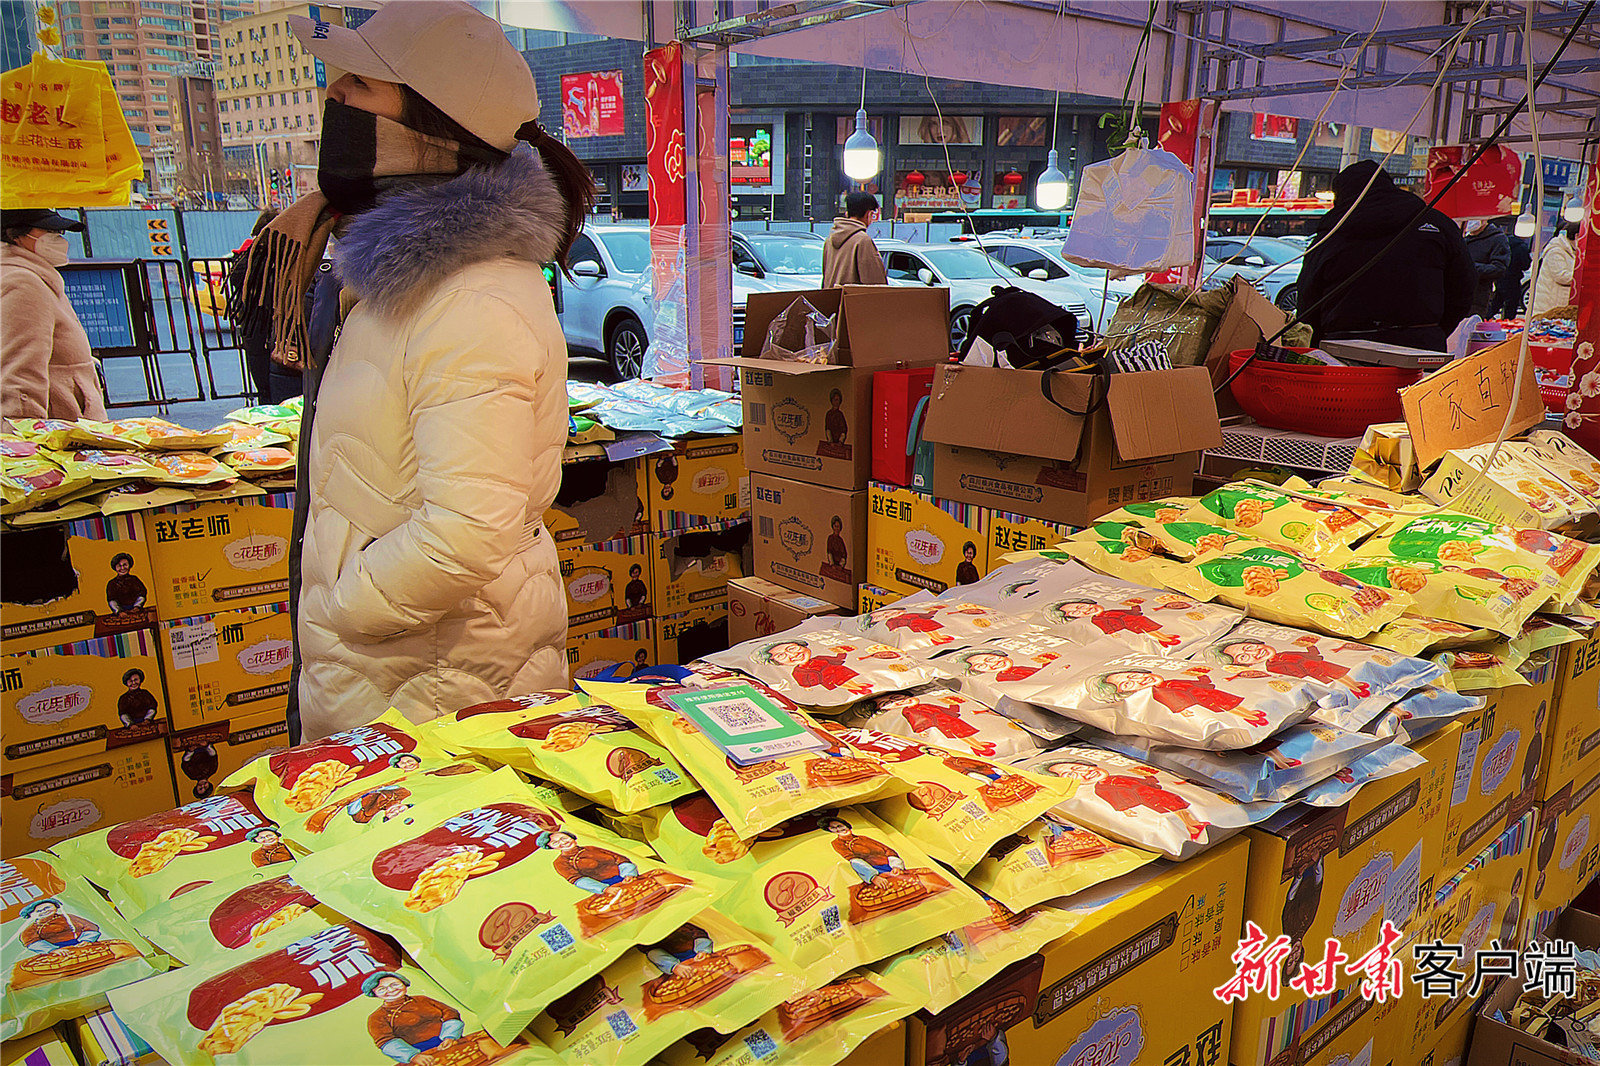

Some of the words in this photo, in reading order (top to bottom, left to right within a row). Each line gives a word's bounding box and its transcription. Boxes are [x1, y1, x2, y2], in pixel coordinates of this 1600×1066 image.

[745, 371, 774, 387] 赵老师
[756, 486, 782, 505] 赵老师
[872, 493, 912, 523] 赵老师
[155, 514, 231, 543] 赵老师
[995, 525, 1046, 551] 赵老师
[233, 542, 282, 560] 花生酥
[910, 538, 940, 558] 花生酥
[247, 646, 290, 665] 花生酥
[1572, 638, 1600, 680] 赵老
[28, 692, 85, 713] 花生酥
[36, 809, 91, 832] 花生酥
